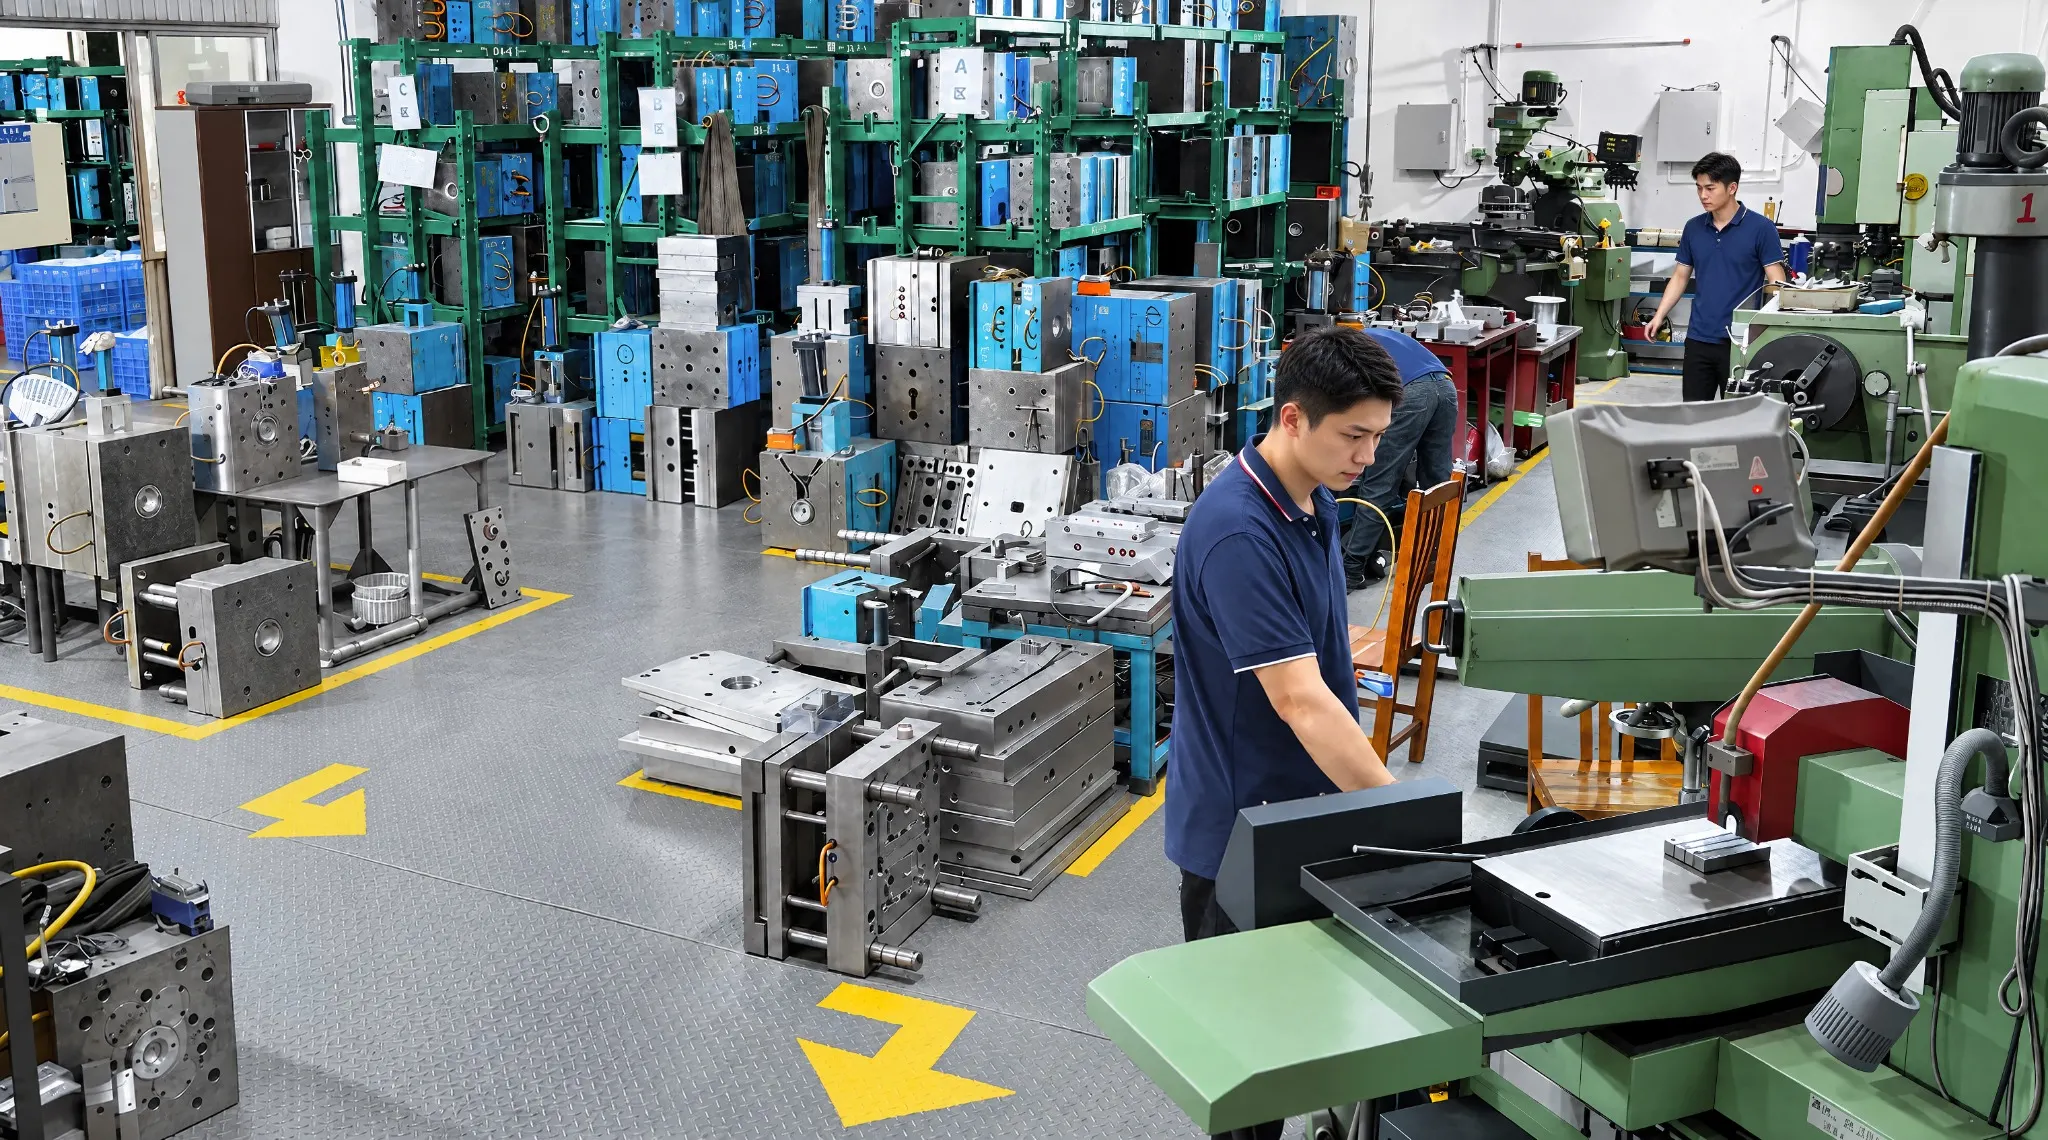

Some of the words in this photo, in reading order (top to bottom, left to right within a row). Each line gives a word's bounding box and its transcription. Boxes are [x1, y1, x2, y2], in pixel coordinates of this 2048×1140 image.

[954, 58, 967, 74] A
[399, 82, 407, 96] C
[653, 97, 662, 111] B
[2016, 192, 2036, 224] 1
